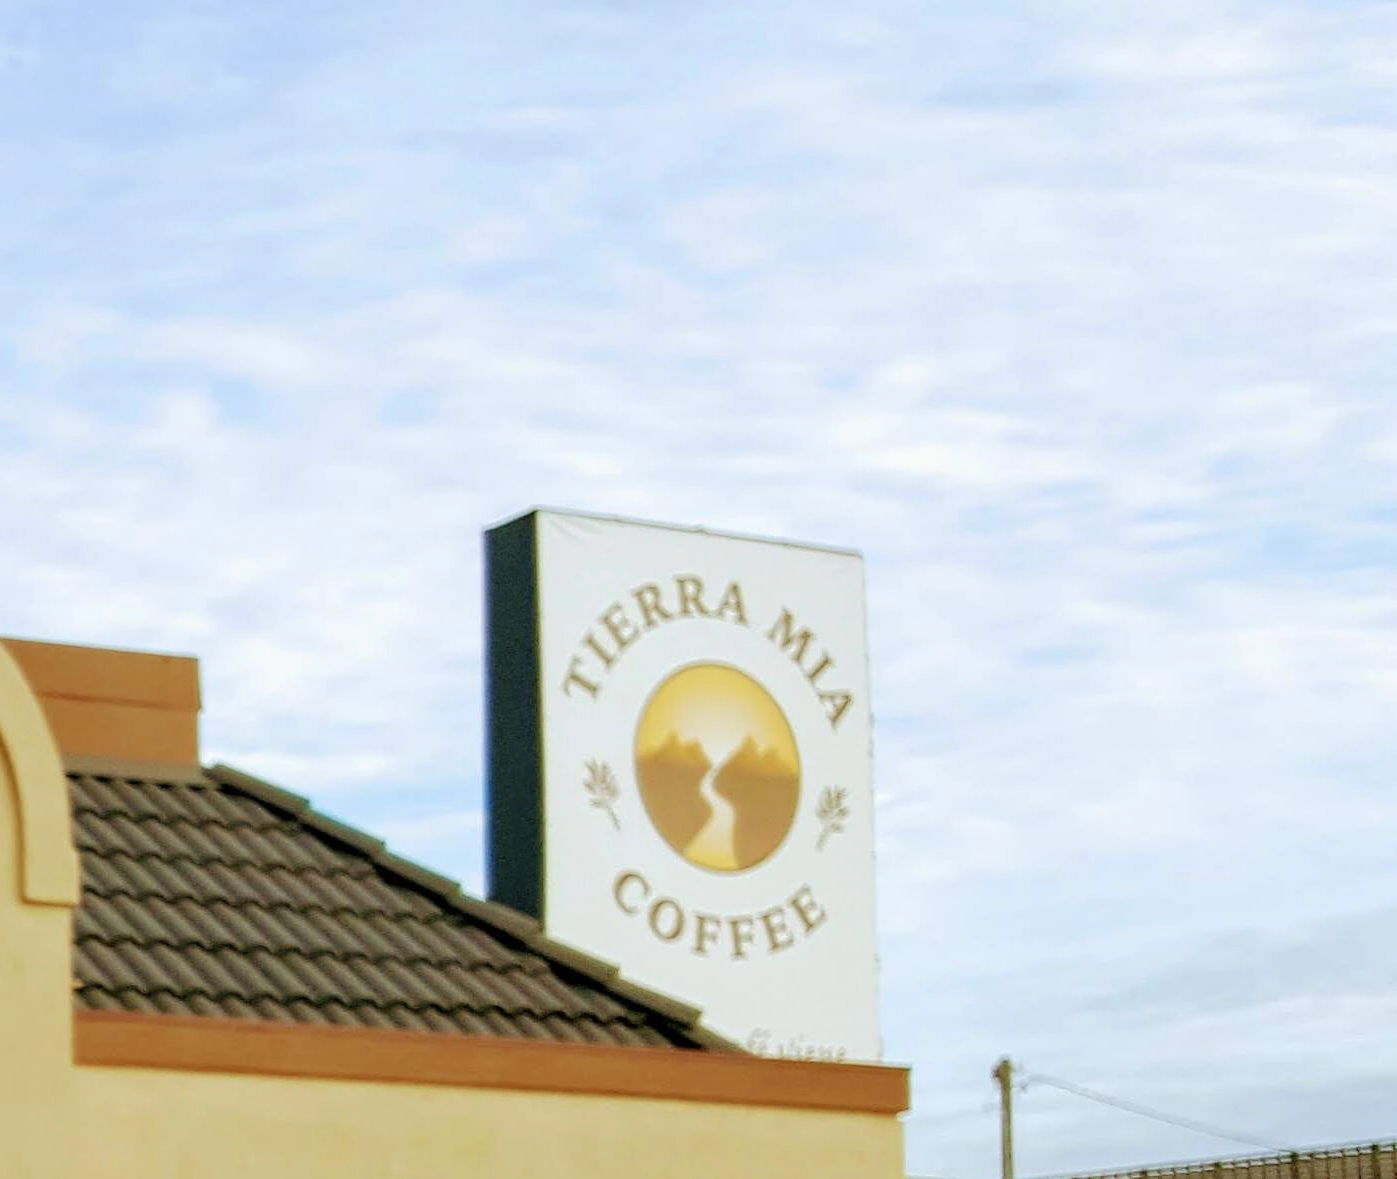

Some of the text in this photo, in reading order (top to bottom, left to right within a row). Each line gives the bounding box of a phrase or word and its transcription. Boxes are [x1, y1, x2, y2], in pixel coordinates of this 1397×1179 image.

[563, 574, 854, 728] TIERRA MIA
[613, 869, 827, 958] COFFEE
